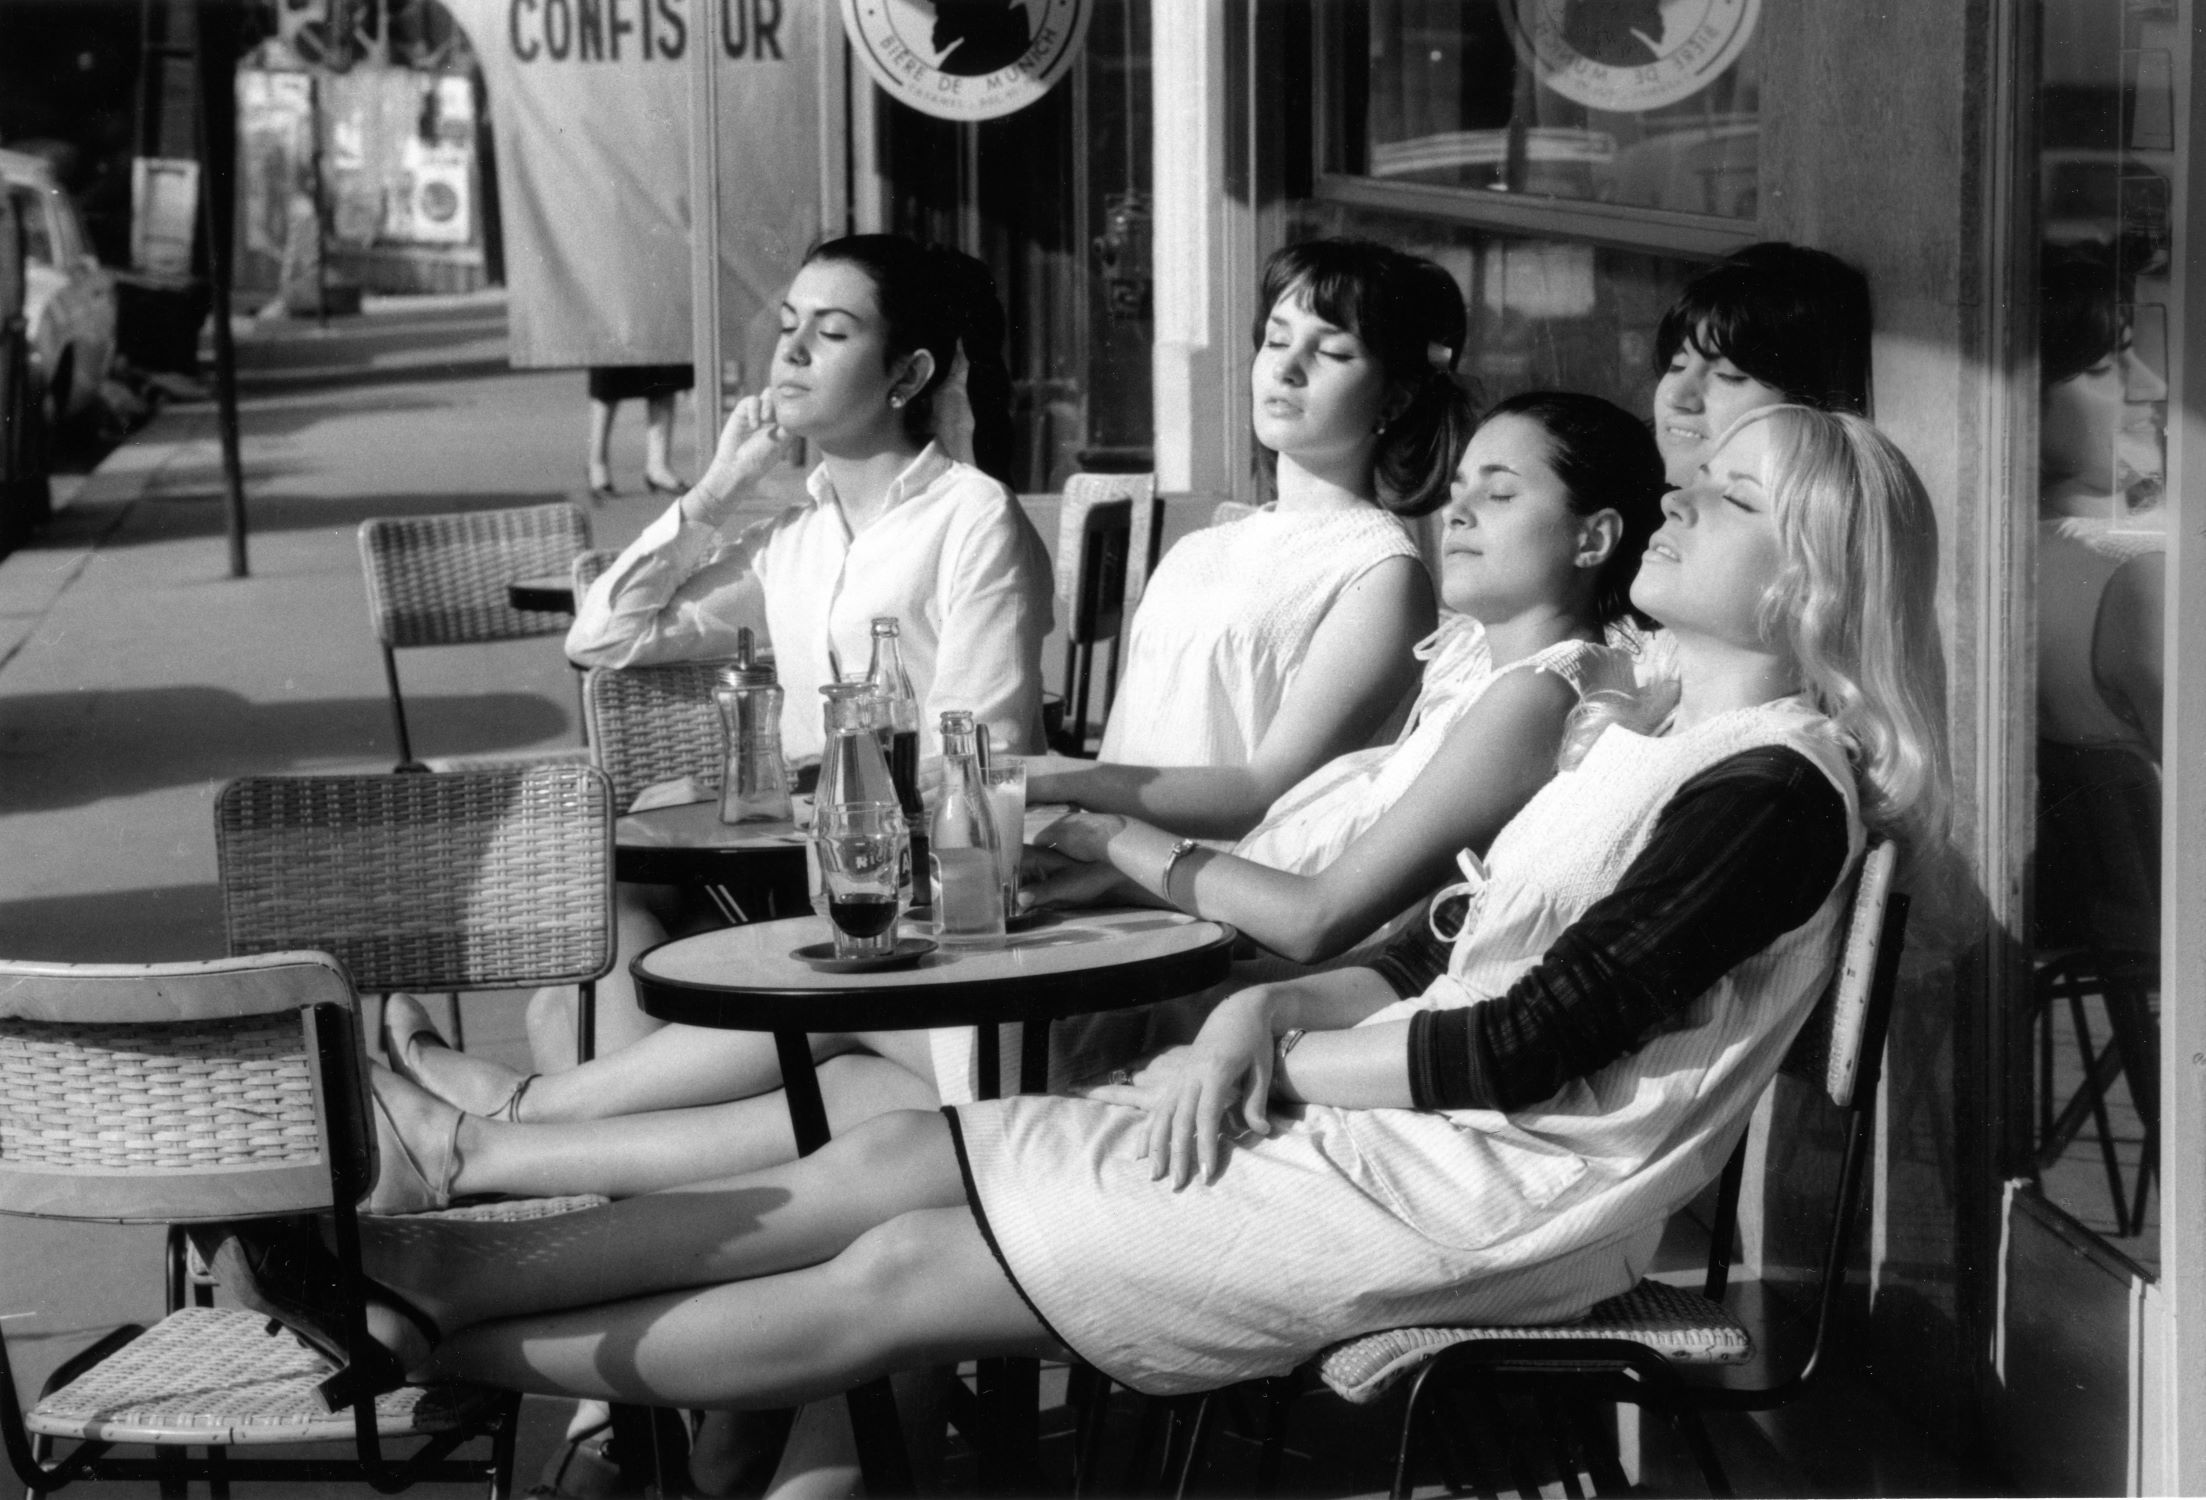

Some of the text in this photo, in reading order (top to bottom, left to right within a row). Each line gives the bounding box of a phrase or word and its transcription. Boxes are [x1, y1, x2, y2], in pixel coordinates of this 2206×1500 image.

[508, 0, 783, 62] CONFISUR
[938, 76, 963, 94] DE
[986, 28, 1057, 90] MUNICH
